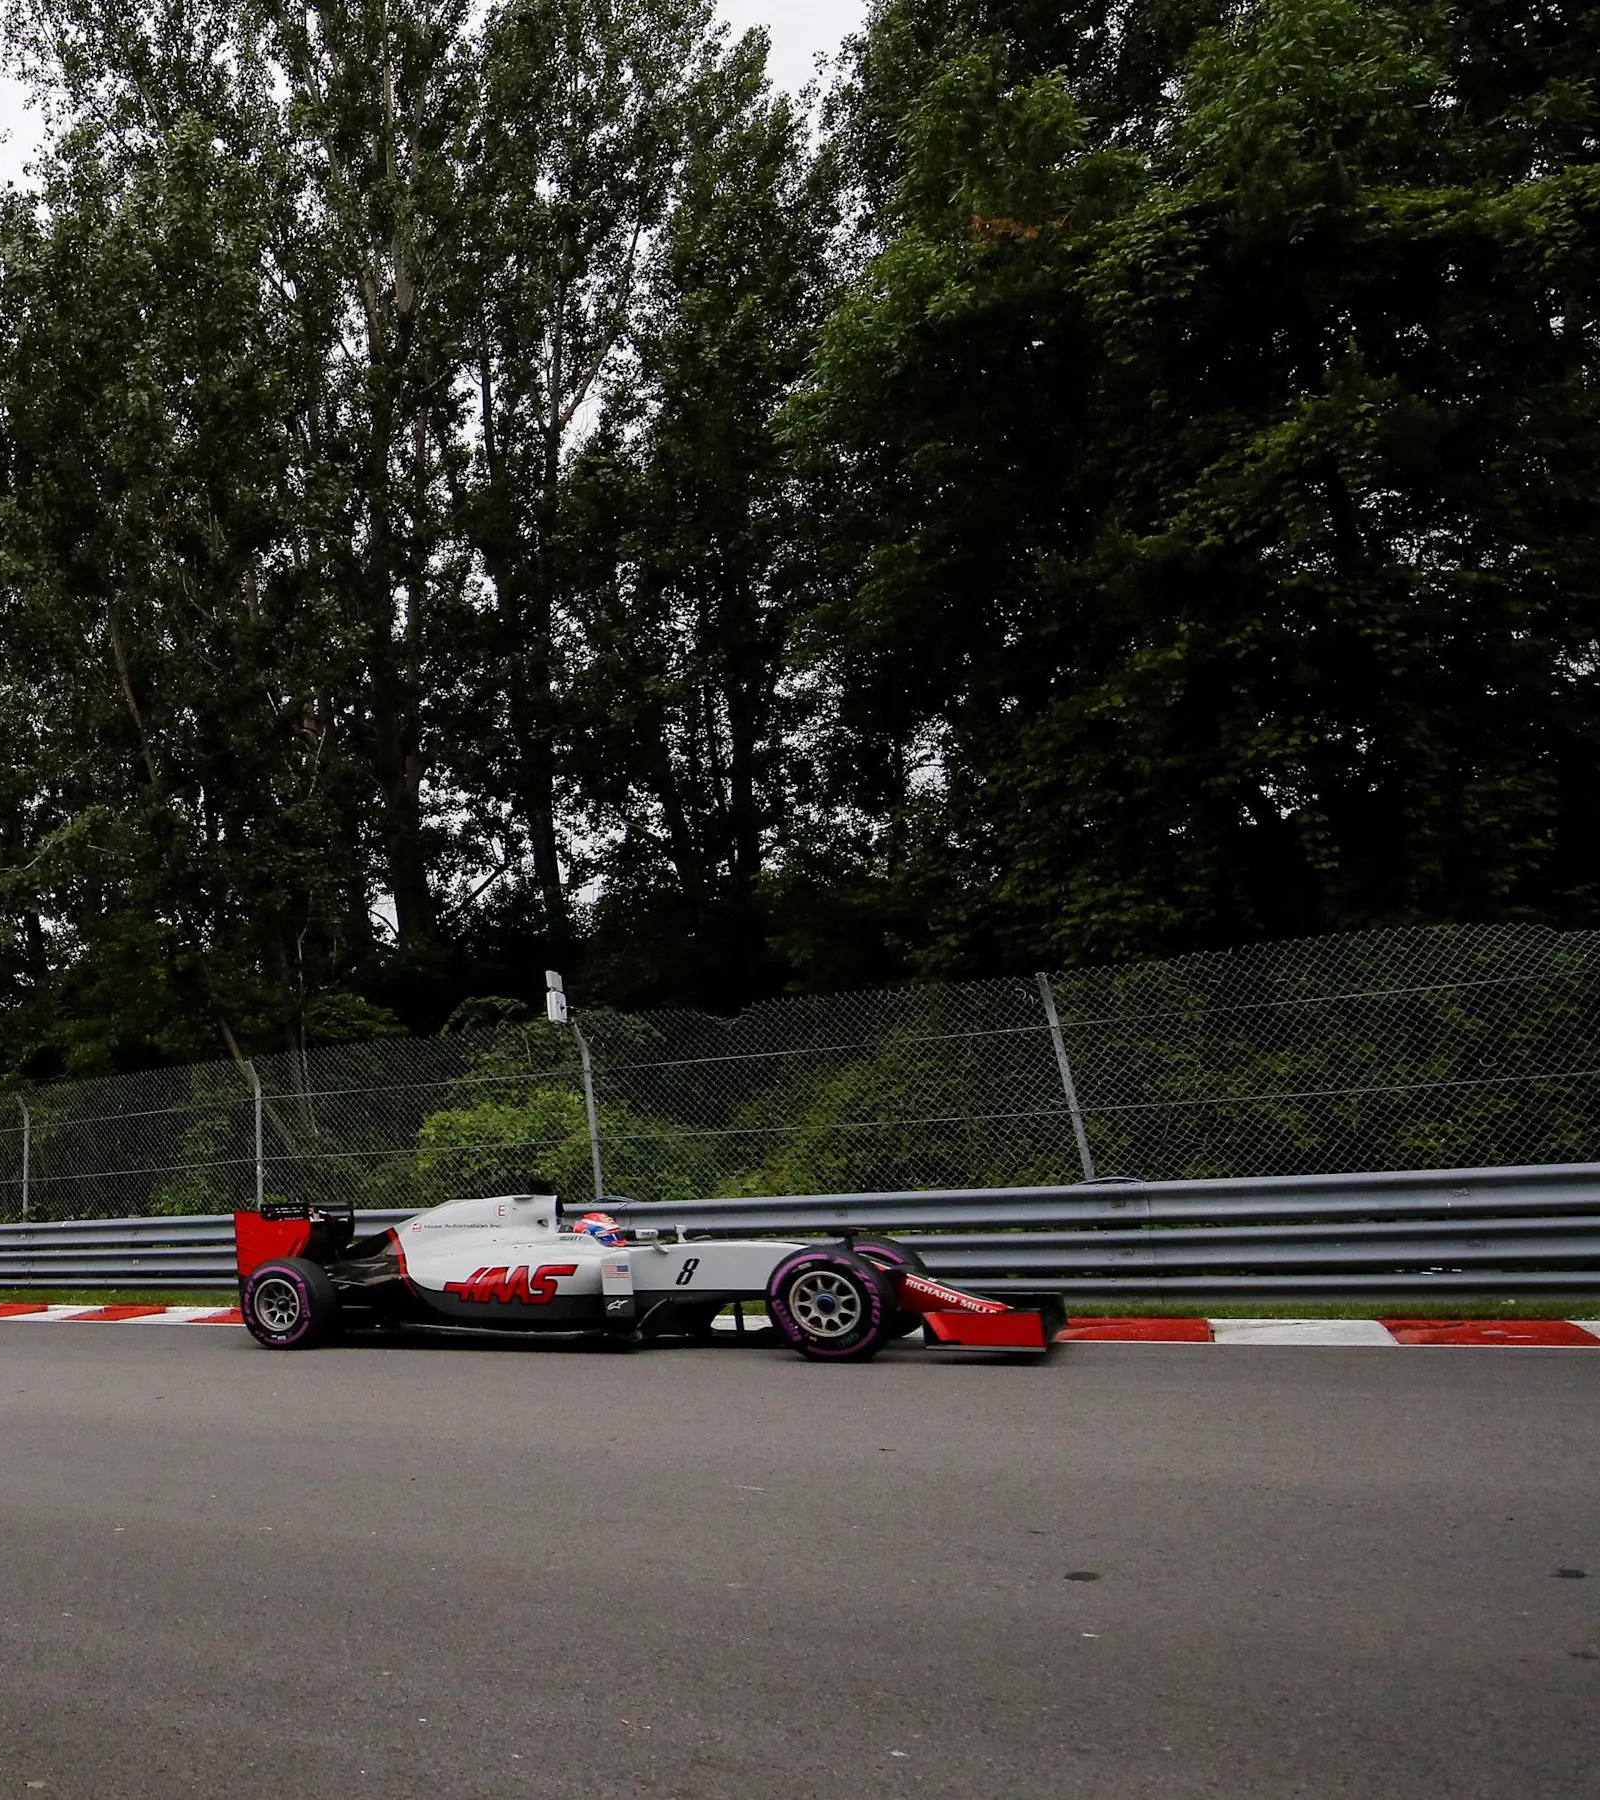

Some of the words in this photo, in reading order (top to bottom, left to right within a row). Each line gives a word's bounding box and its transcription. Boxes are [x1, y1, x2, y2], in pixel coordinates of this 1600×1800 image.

[498, 1205, 505, 1216] E
[443, 1264, 578, 1304] HAAS
[676, 1258, 699, 1285] 8
[905, 1278, 958, 1303] RICHARD
